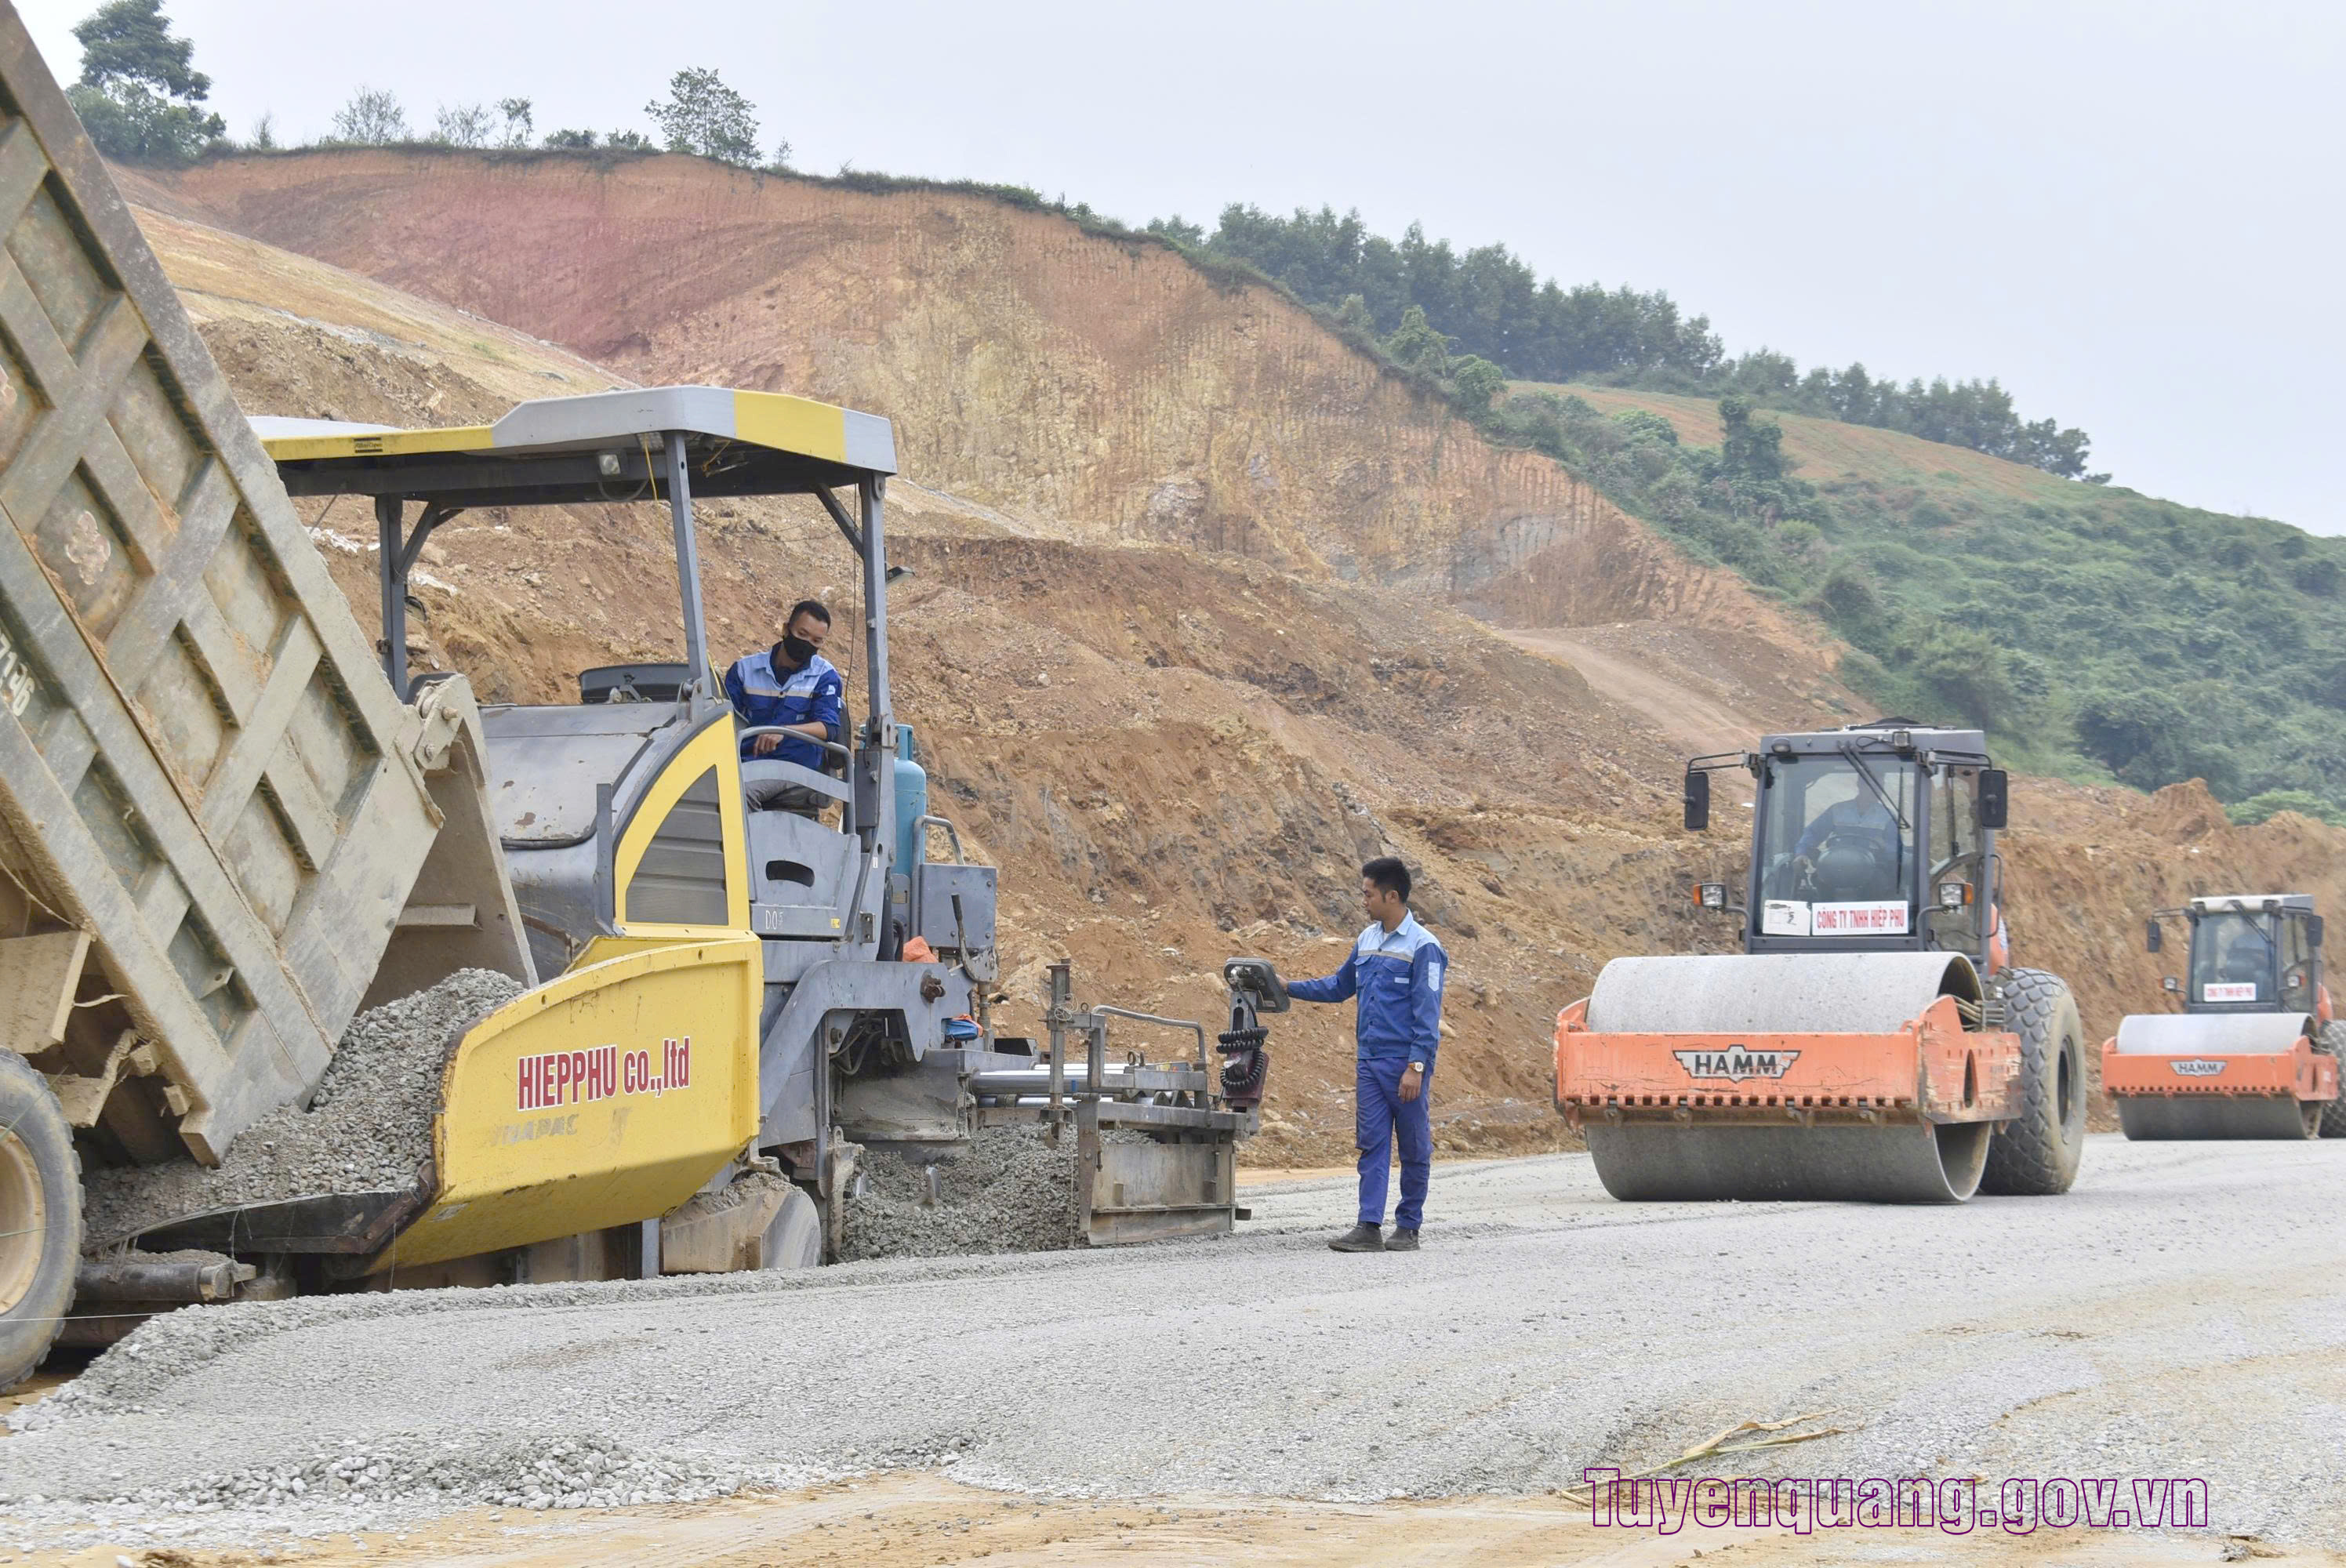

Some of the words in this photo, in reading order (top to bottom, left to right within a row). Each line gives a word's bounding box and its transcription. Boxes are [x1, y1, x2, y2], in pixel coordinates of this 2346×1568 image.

[1817, 906, 1837, 928] CÔNG
[1839, 910, 1847, 928] TY
[1850, 909, 1868, 927] TNHH
[1695, 1054, 1778, 1075] HAMM
[2178, 1063, 2217, 1073] HAMM
[518, 1044, 617, 1111] HIEPPHU
